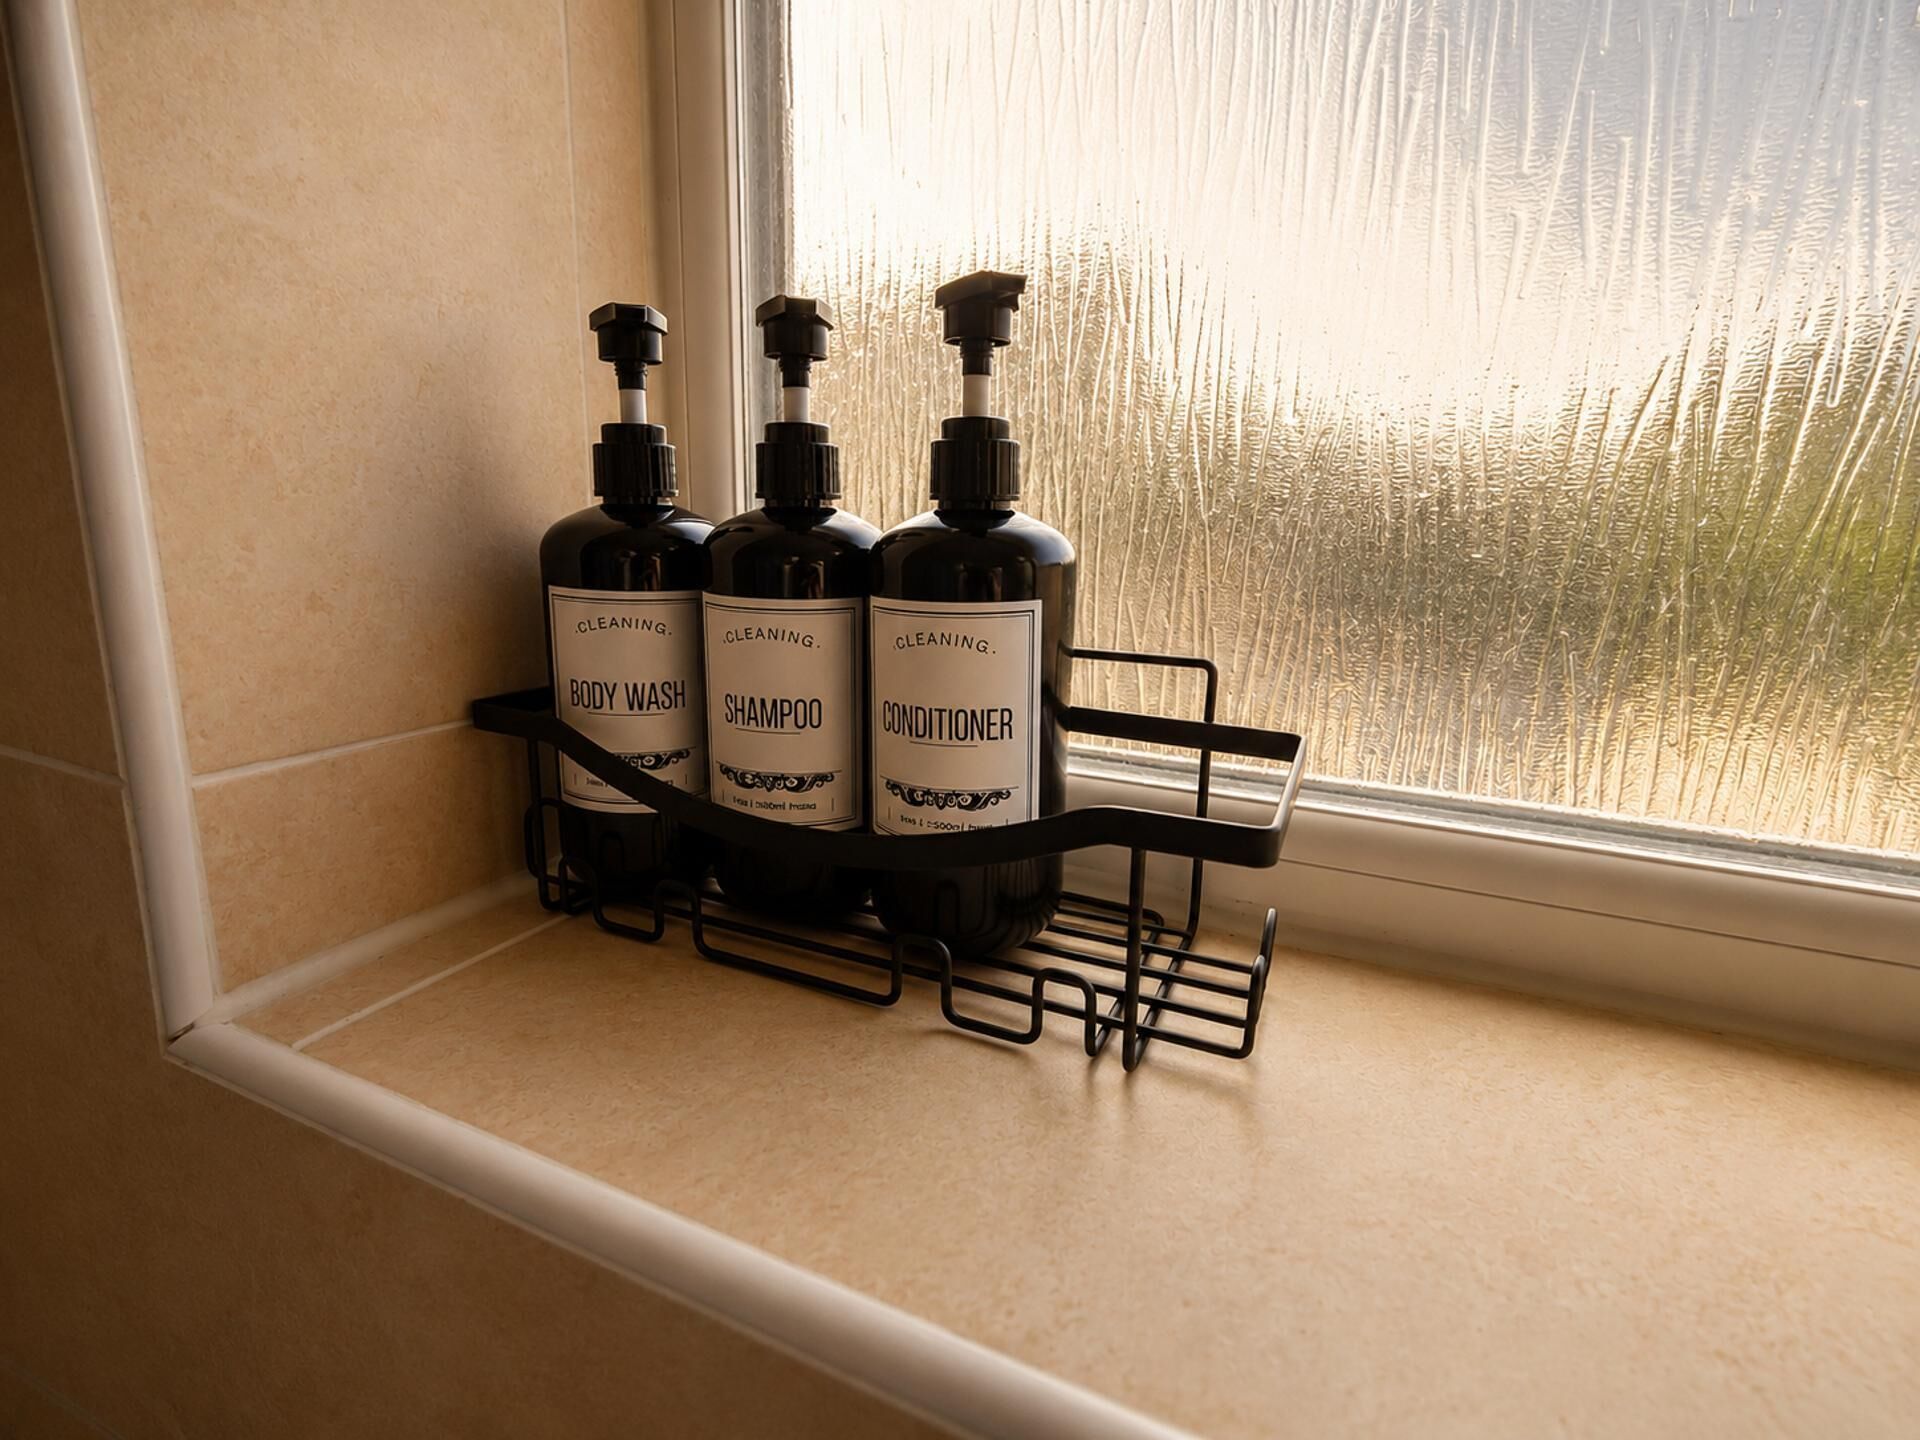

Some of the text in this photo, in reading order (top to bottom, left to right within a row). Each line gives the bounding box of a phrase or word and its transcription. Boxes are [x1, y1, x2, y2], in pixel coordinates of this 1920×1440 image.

[569, 678, 686, 711] BODY WASH
[723, 693, 823, 729] SHAMPOO
[882, 700, 1014, 742] CONDITIONER
